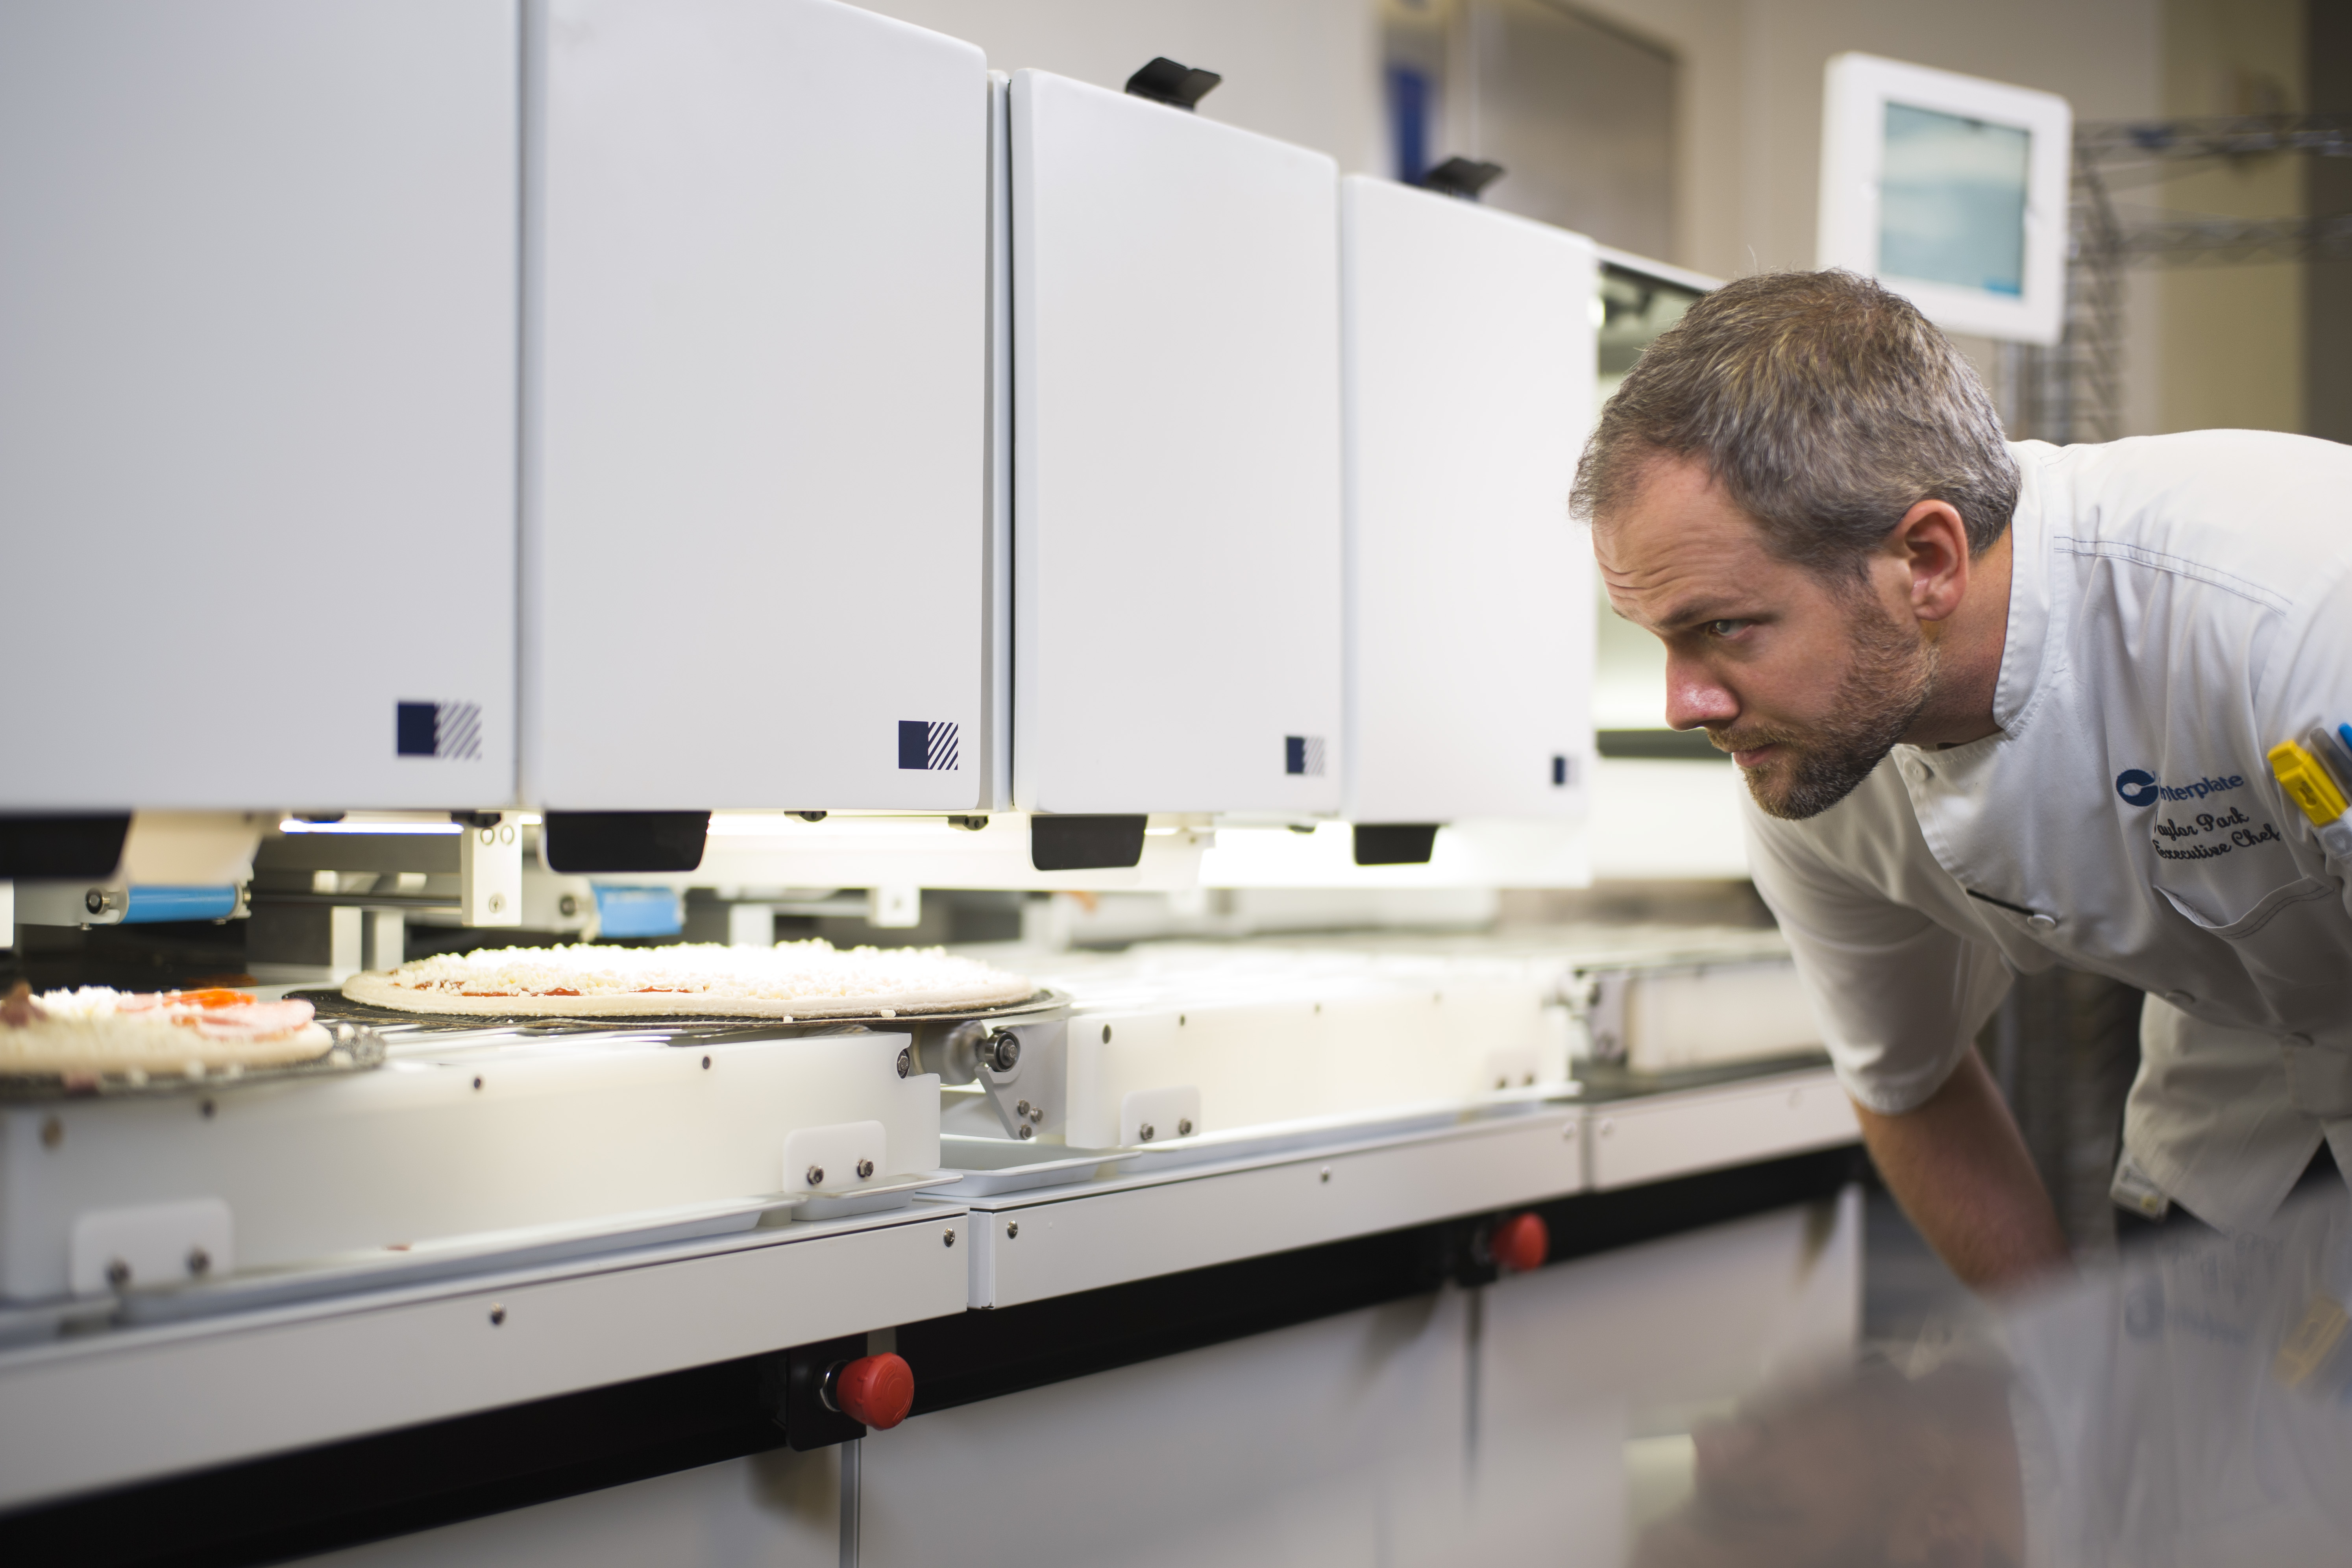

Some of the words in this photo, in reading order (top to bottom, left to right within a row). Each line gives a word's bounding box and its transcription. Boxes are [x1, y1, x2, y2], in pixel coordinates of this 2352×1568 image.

[2116, 769, 2244, 806] Cnterplate
[2152, 839, 2232, 860] Executive
[2231, 823, 2281, 848] Chef
[2154, 810, 2199, 841] aylor
[2196, 807, 2250, 832] Park
